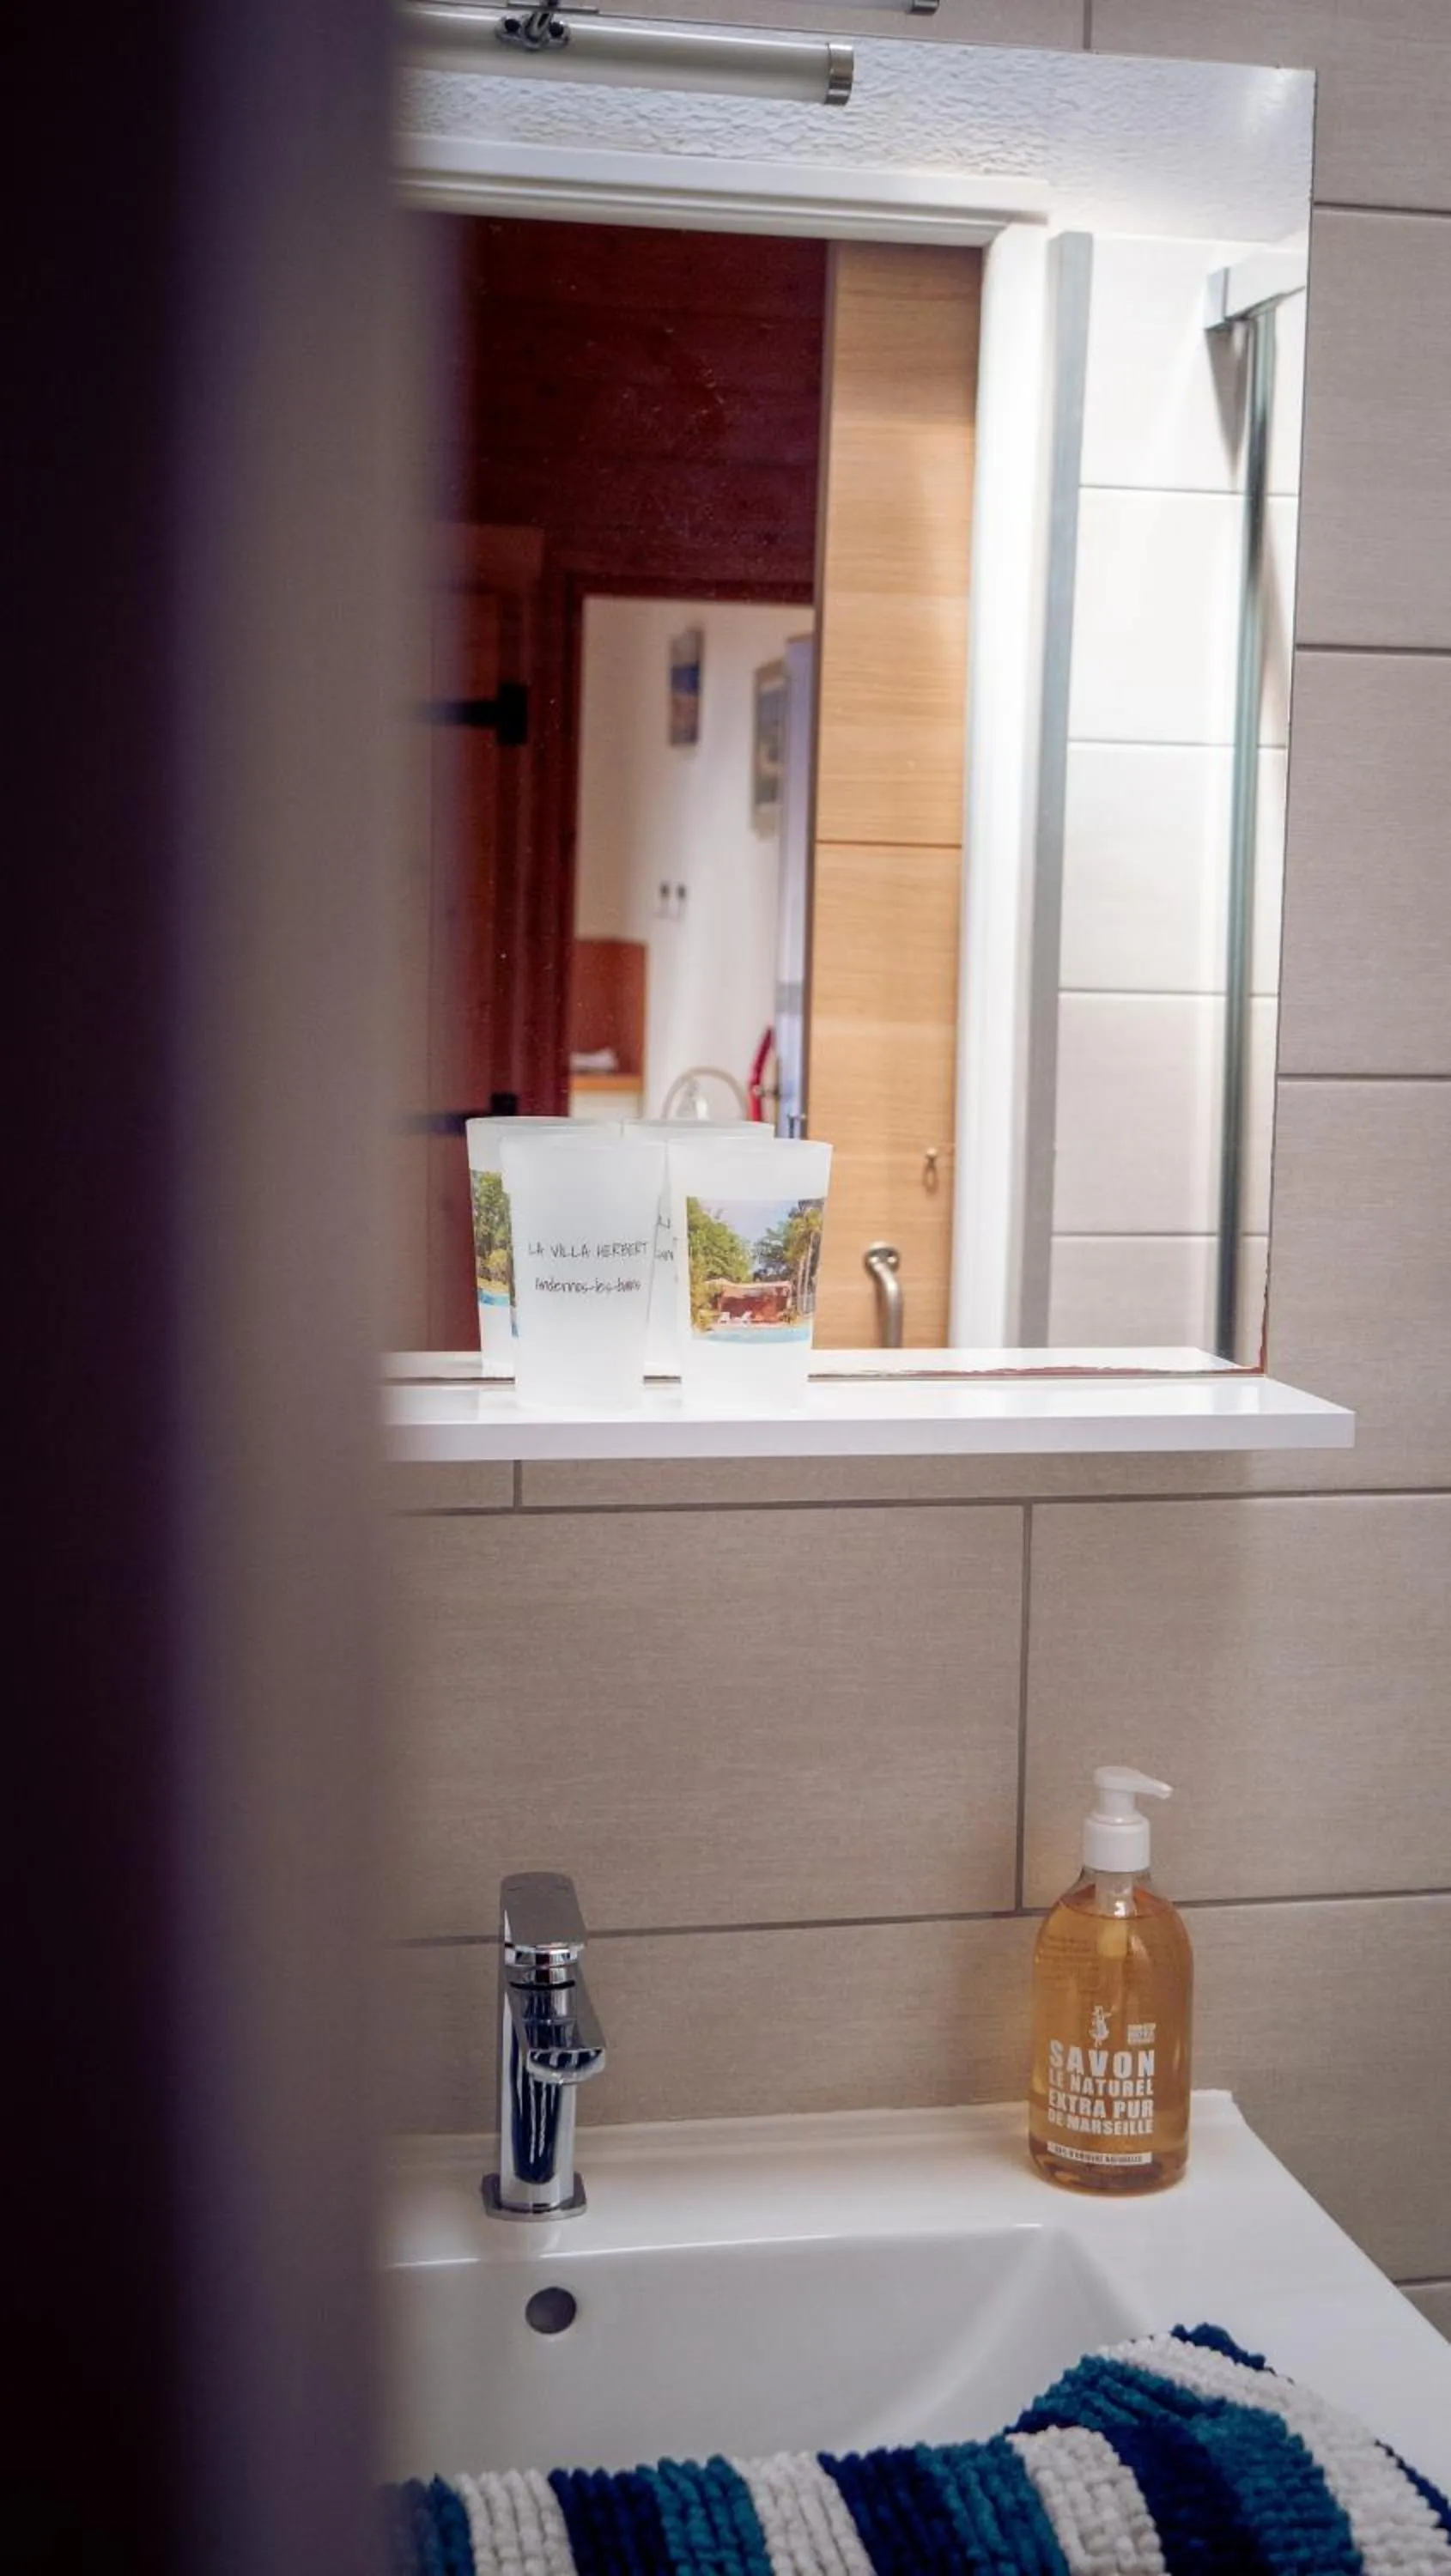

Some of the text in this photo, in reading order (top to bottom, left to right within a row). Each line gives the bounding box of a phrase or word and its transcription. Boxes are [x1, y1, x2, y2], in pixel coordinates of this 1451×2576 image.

[528, 1242, 545, 1256] LA
[550, 1242, 590, 1258] VILLA
[1048, 2038, 1156, 2079] SAVON
[1048, 2067, 1154, 2098] LE NATUREL
[1048, 2087, 1154, 2119] EXTRA PUR
[1047, 2106, 1154, 2136] DE MARSEILLE
